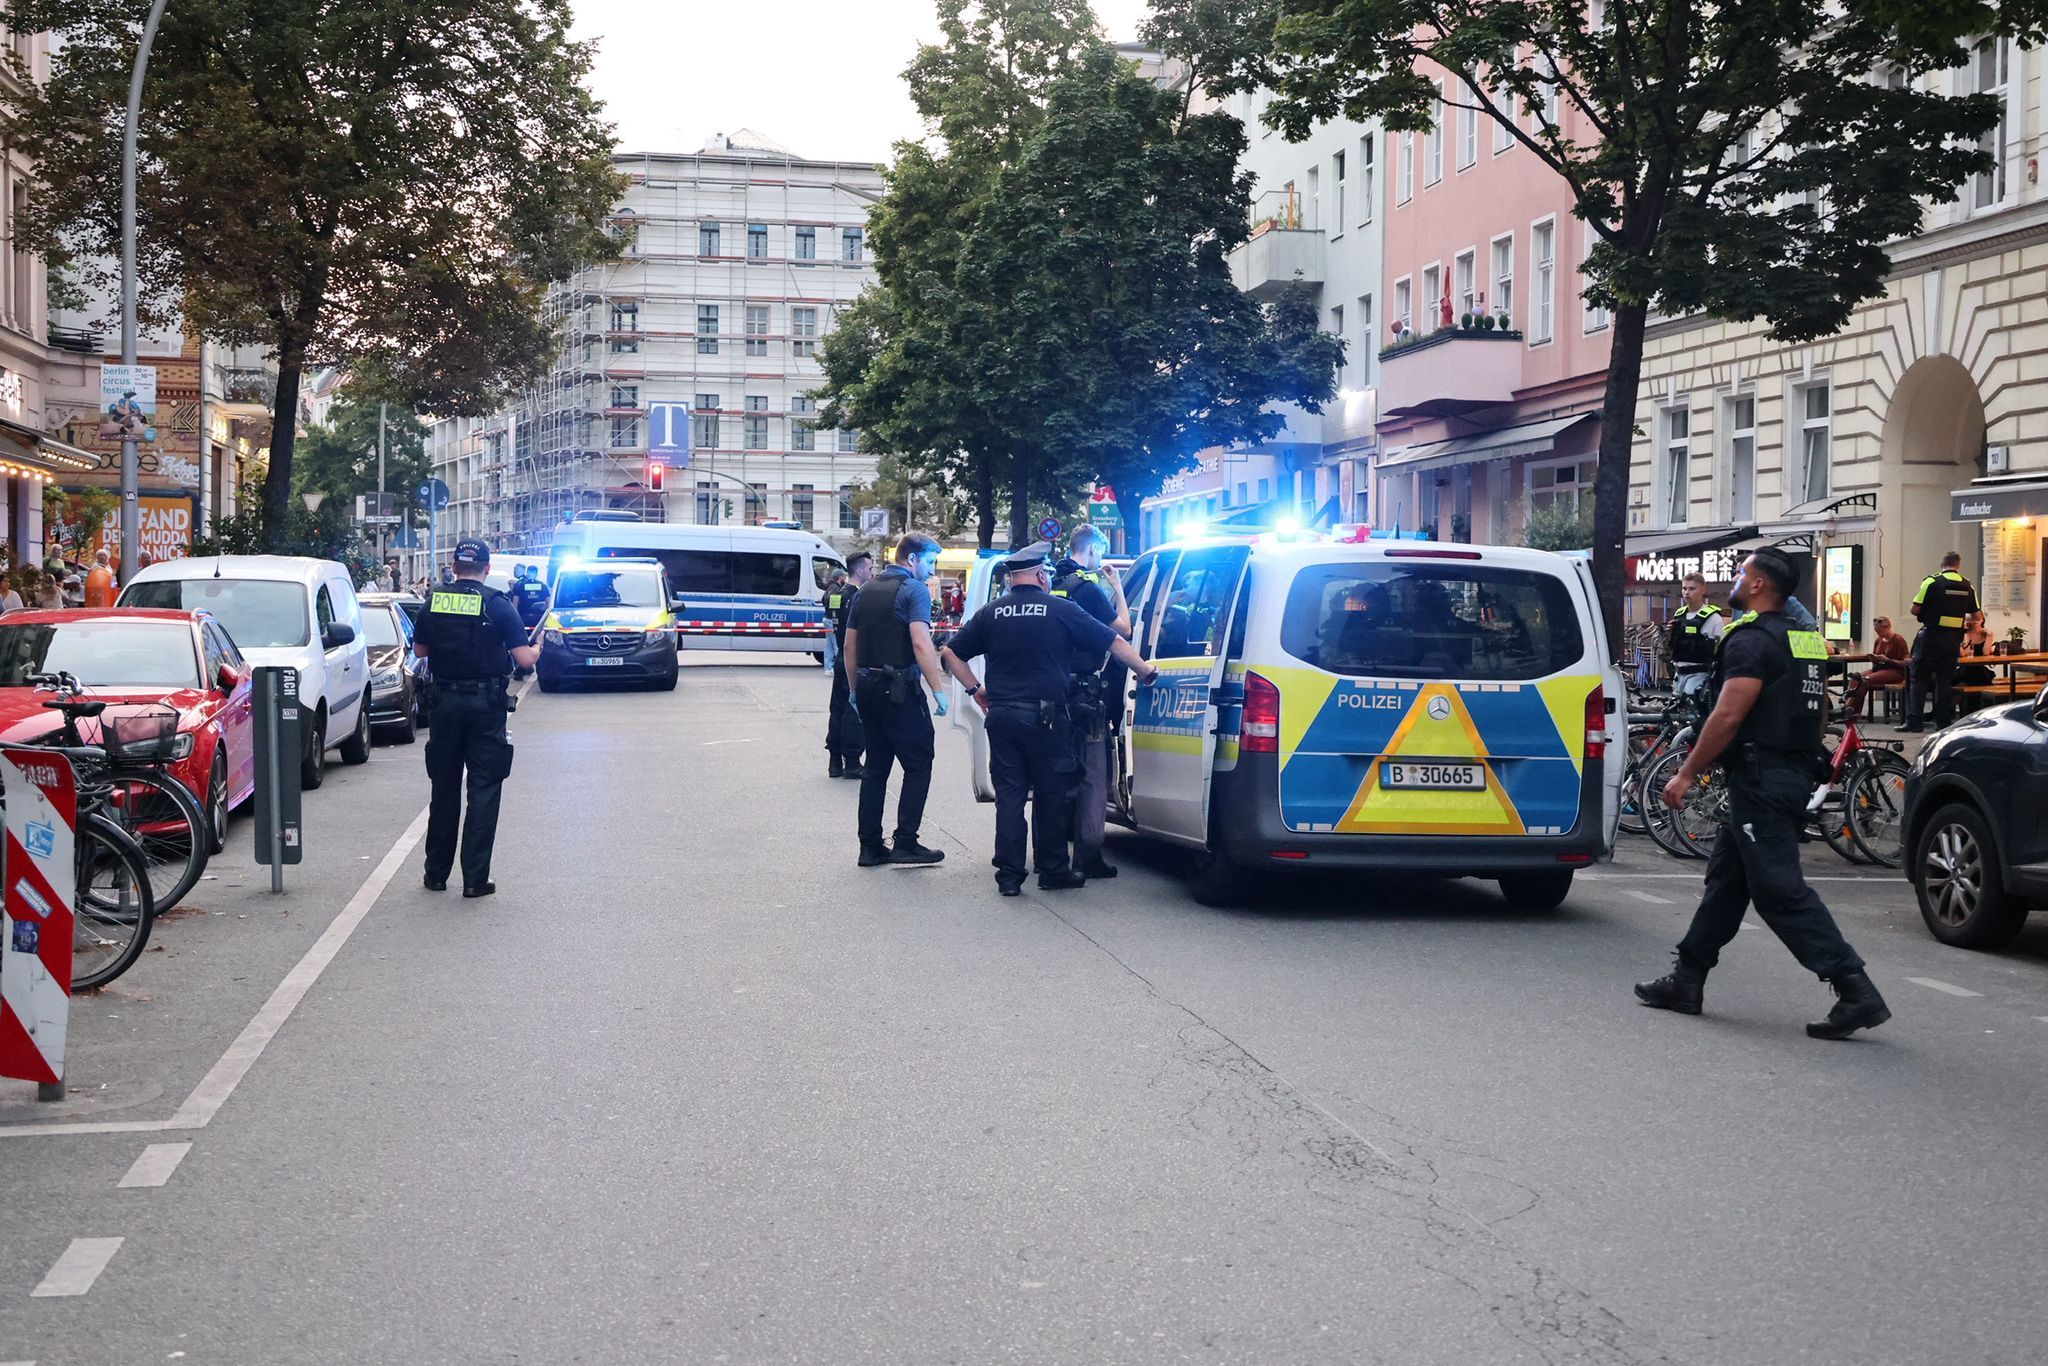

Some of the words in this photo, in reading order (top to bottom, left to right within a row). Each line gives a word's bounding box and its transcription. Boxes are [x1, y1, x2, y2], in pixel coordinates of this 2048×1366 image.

[103, 367, 129, 375] berlin
[102, 386, 136, 395] festival
[650, 403, 687, 447] T
[1960, 501, 1993, 516] Krombacher
[137, 507, 189, 530] FAND
[141, 530, 189, 545] MUDDA
[459, 543, 481, 551] POLIZEI
[1635, 552, 1674, 581] MÖGE
[432, 594, 479, 613] POLIZEI
[994, 603, 1048, 619] POLIZEI
[753, 612, 787, 621] POLIZEI
[1807, 664, 1819, 679] BE
[283, 669, 296, 696] FACH
[1150, 687, 1200, 720] POLIZEI
[1338, 694, 1402, 709] POLIZEI
[1392, 766, 1404, 783] B
[1420, 767, 1473, 784] 30665
